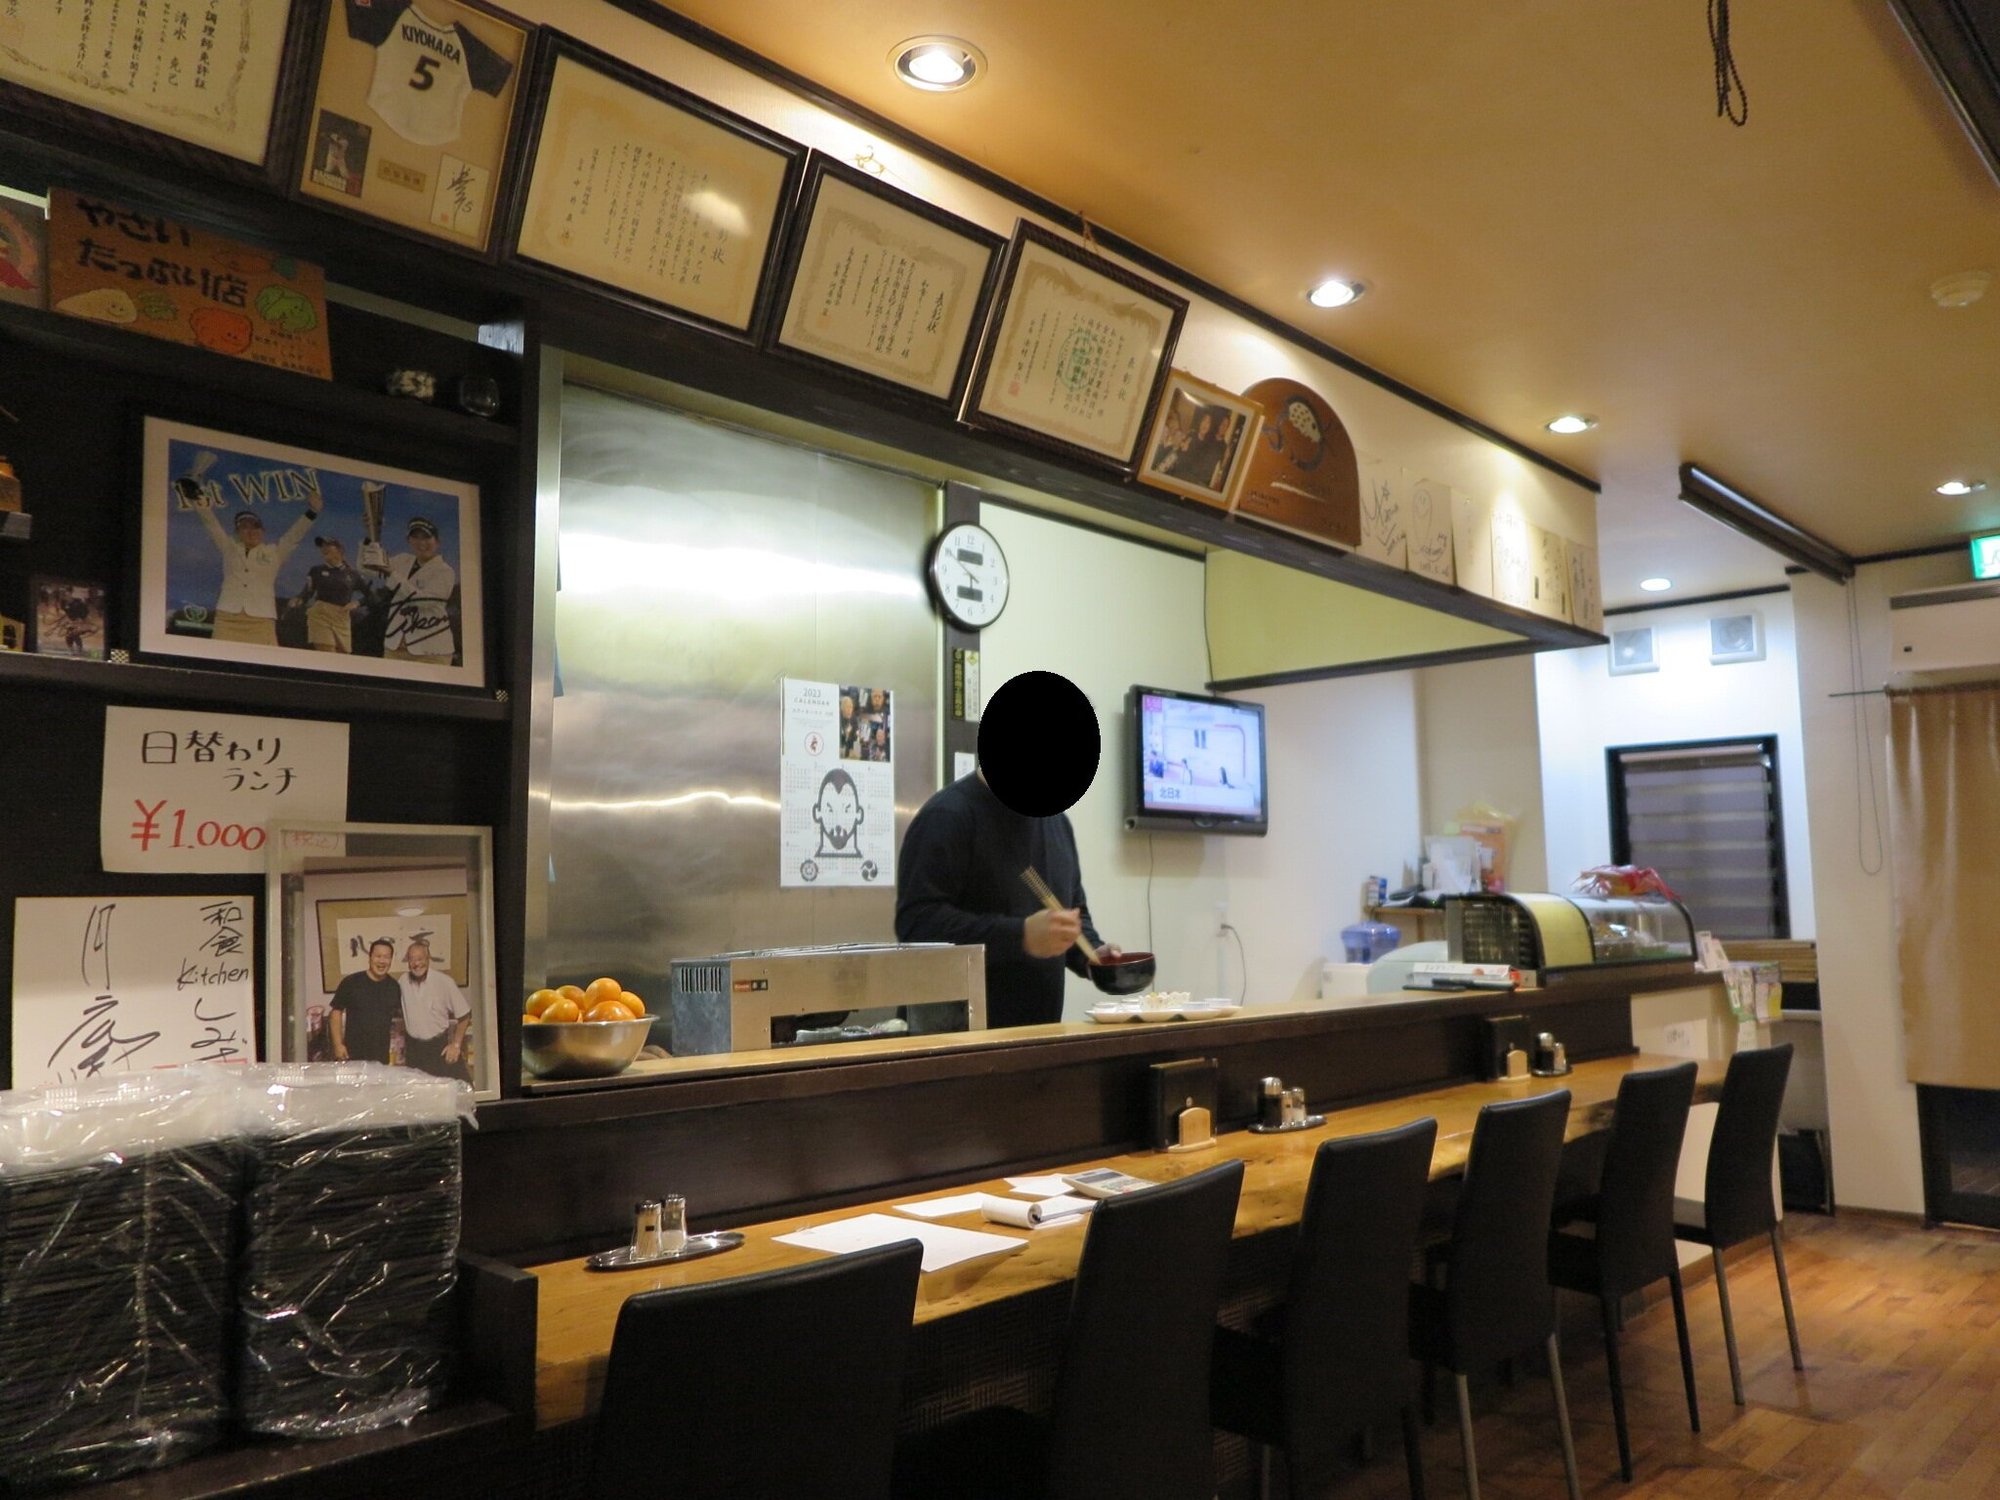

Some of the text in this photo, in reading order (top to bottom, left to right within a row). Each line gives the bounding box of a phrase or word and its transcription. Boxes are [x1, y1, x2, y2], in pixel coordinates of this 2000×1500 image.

[401, 23, 461, 66] KIYOHARA
[408, 54, 441, 92] 5
[76, 237, 249, 308] たっぷり店
[228, 467, 322, 506] WIN
[141, 729, 281, 765] 日替わり
[223, 766, 298, 796] ランチ
